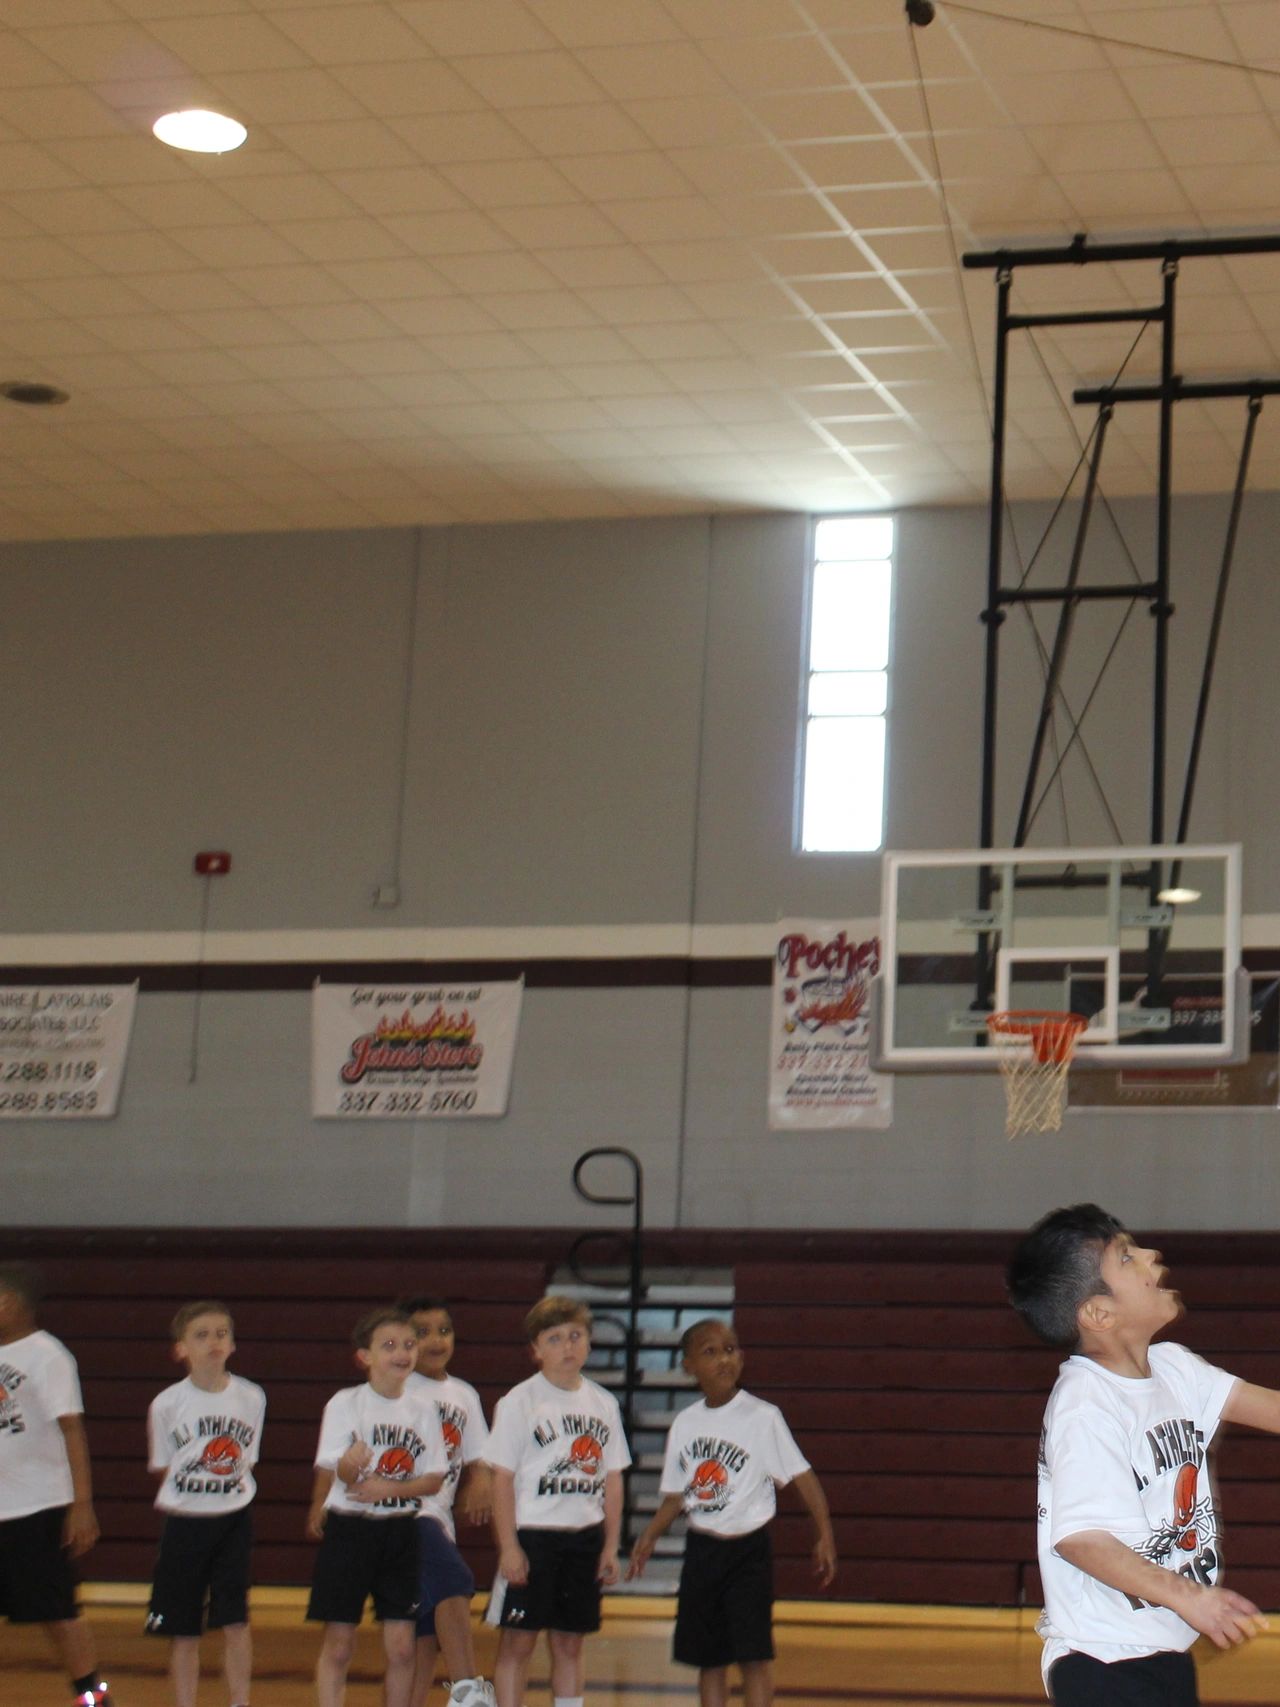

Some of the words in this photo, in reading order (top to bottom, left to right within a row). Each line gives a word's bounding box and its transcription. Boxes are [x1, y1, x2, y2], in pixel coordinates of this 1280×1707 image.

[422, 1041, 483, 1071] Store
[198, 1416, 255, 1448] ATHLETICS
[562, 1414, 610, 1448] ATHLETICS
[692, 1436, 751, 1473] ATHLETICS
